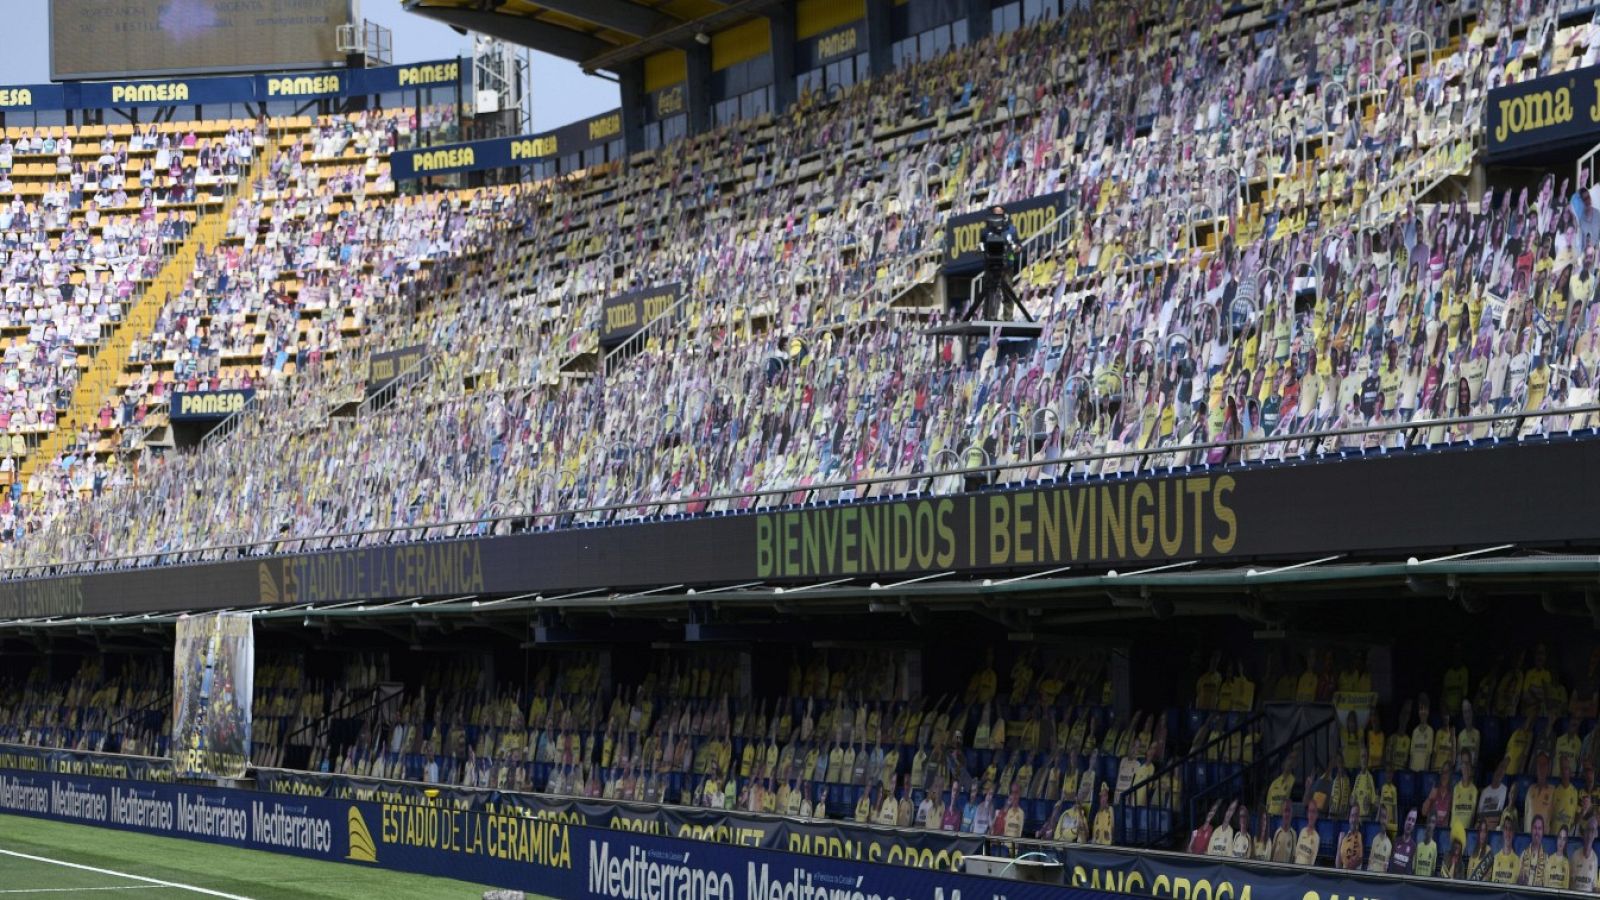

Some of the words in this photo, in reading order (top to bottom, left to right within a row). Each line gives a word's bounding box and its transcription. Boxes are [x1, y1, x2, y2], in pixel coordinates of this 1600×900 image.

[112, 82, 189, 103] PAMESA
[268, 75, 340, 96] PAMESA
[399, 63, 458, 87] PAMESA
[511, 135, 557, 160] PAMESA
[588, 113, 620, 141] PAMESA
[413, 147, 475, 172] PAMESA
[181, 392, 245, 415] PAMESA
[756, 498, 956, 578] BIENVENIDOS
[989, 475, 1237, 565] BENVINGUTS
[282, 555, 343, 604] ESTADIO
[347, 551, 366, 601] DE
[370, 548, 390, 598] LA
[394, 541, 485, 596] CERAMICA
[51, 780, 108, 822] Mediterráneo
[111, 786, 173, 830] Mediterráneo
[177, 792, 247, 841] Mediterráneo
[252, 800, 332, 853] Mediterráneo
[382, 803, 438, 849] ESTADIO
[441, 809, 460, 851] DE
[465, 808, 484, 856] LA
[486, 814, 572, 870] CERAMICA
[588, 839, 735, 900] Mediterráneo
